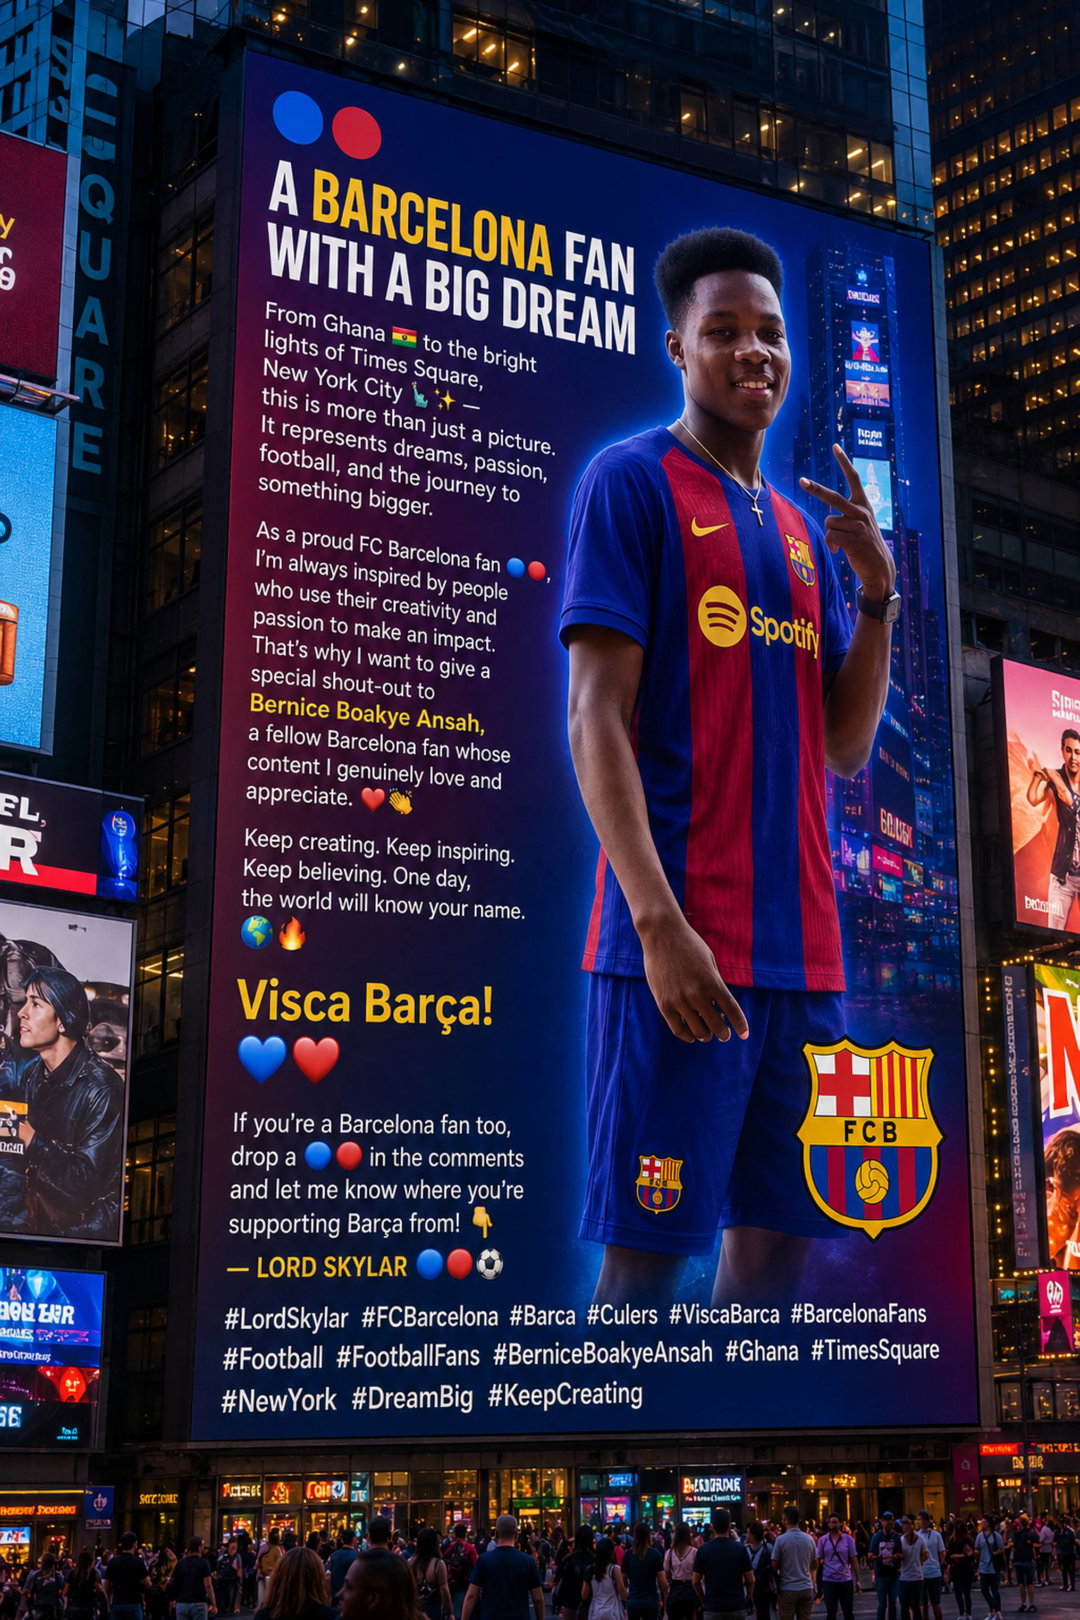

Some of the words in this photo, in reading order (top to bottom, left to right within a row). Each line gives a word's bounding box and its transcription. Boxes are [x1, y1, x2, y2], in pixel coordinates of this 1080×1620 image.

[269, 160, 298, 216] A
[313, 168, 553, 276] BARCELONA
[566, 231, 634, 295] FAN
[268, 222, 373, 297] WITH
[385, 252, 412, 305] A
[426, 259, 489, 321] BIG
[503, 277, 635, 355] DREAM
[266, 301, 316, 328] From
[324, 314, 385, 342] Ghana
[423, 335, 442, 352] to
[448, 339, 477, 360] the
[484, 346, 536, 373] bright
[265, 329, 318, 356] lights
[325, 344, 345, 361] of
[351, 346, 407, 373] Times
[414, 359, 482, 391] Square,
[264, 358, 308, 382] New
[315, 367, 358, 392] York
[365, 378, 402, 404] City
[262, 387, 298, 409] this
[306, 394, 320, 413] is
[328, 403, 376, 423] more
[383, 409, 425, 432] than
[431, 417, 465, 439] just
[472, 429, 481, 442] a
[489, 429, 555, 455] picture.
[262, 415, 275, 434] It
[283, 423, 387, 452] represents
[394, 439, 467, 469] dreams,
[475, 456, 547, 483] passion,
[260, 443, 340, 476] football,
[348, 463, 382, 480] and
[389, 465, 420, 486] the
[425, 471, 496, 502] journey
[502, 485, 520, 502] to
[259, 477, 362, 509] something
[370, 489, 432, 516] bigger.
[256, 521, 279, 540] As
[286, 530, 295, 542] a
[302, 532, 353, 551] proud
[360, 536, 382, 555] FC
[389, 540, 469, 570] Barcelona
[475, 553, 500, 572] fan
[256, 549, 282, 569] I'm
[289, 555, 347, 580] always
[354, 562, 420, 588] inspired
[427, 572, 447, 595] by
[453, 581, 508, 601] people
[255, 579, 293, 599] who
[300, 588, 330, 603] use
[337, 589, 377, 609] their
[383, 599, 461, 624] creativity
[466, 609, 496, 625] and
[254, 611, 323, 631] passion
[330, 617, 348, 634] to
[355, 621, 401, 640] make
[407, 630, 427, 644] an
[434, 628, 495, 652] impact.
[750, 605, 820, 660] Spotify
[252, 635, 307, 658] That's
[314, 643, 351, 666] why
[358, 647, 361, 664] I
[368, 653, 410, 669] want
[416, 655, 433, 672] to
[440, 658, 475, 678] give
[481, 666, 490, 678] a
[251, 668, 315, 687] special
[323, 672, 411, 697] shout-out
[417, 683, 435, 699] to
[251, 693, 329, 718] Bernice
[337, 701, 410, 729] Boakye
[417, 709, 484, 736] Ansah,
[249, 728, 258, 741] a
[266, 724, 321, 746] fellow
[328, 730, 416, 754] Barcelona
[422, 738, 449, 757] fan
[456, 742, 510, 763] whose
[248, 756, 320, 775] content
[327, 758, 330, 775] I
[337, 763, 424, 787] genuinely
[430, 767, 464, 786] love
[471, 773, 501, 789] and
[246, 786, 352, 806] appreciate.
[245, 828, 292, 853] Keep
[299, 834, 379, 858] creating.
[387, 837, 431, 861] Keep
[438, 840, 514, 866] inspiring.
[244, 858, 291, 883] Keep
[299, 860, 386, 888] believing.
[394, 867, 430, 886] One
[436, 869, 470, 892] day,
[242, 888, 273, 907] the
[280, 891, 332, 910] world
[338, 893, 368, 911] will
[375, 894, 423, 914] know
[429, 902, 468, 919] your
[474, 905, 524, 919] name.
[237, 978, 350, 1022] Visca
[366, 983, 492, 1035] Barça!
[234, 1112, 247, 1132] If
[254, 1113, 314, 1137] you're
[321, 1119, 331, 1133] a
[340, 1114, 434, 1134] Barcelona
[441, 1114, 469, 1134] fan
[476, 1117, 510, 1137] too,
[844, 1120, 898, 1143] FCB
[232, 1145, 278, 1171] drop
[285, 1151, 295, 1166] a
[370, 1147, 385, 1166] in
[392, 1147, 422, 1166] the
[429, 1150, 524, 1167] comments
[230, 1178, 268, 1199] and
[276, 1178, 301, 1199] let
[308, 1184, 338, 1199] me
[346, 1179, 397, 1199] know
[404, 1179, 461, 1199] where
[468, 1180, 523, 1204] you're
[229, 1213, 340, 1239] supporting
[348, 1213, 402, 1238] Barça
[409, 1212, 459, 1232] from!
[258, 1257, 316, 1277] LORD
[324, 1256, 406, 1277] SKYLAR
[225, 1306, 349, 1334] #LordSkylar
[362, 1305, 498, 1327] #FCBarcelona
[510, 1305, 575, 1325] #Barca
[587, 1304, 657, 1324] #Culers
[669, 1304, 779, 1324] #ViscaBarca
[791, 1303, 926, 1323] #BarcelonaFans
[223, 1345, 322, 1370] #Football
[337, 1344, 480, 1368] #FootballFans
[493, 1340, 712, 1369] #BerniceBoakyeAnsah
[725, 1340, 798, 1361] #Ghana
[811, 1338, 939, 1365] #TimesSquare
[221, 1387, 336, 1413] #NewYork
[352, 1384, 472, 1413] #DreamBig
[488, 1381, 642, 1411] #KeepCreating
